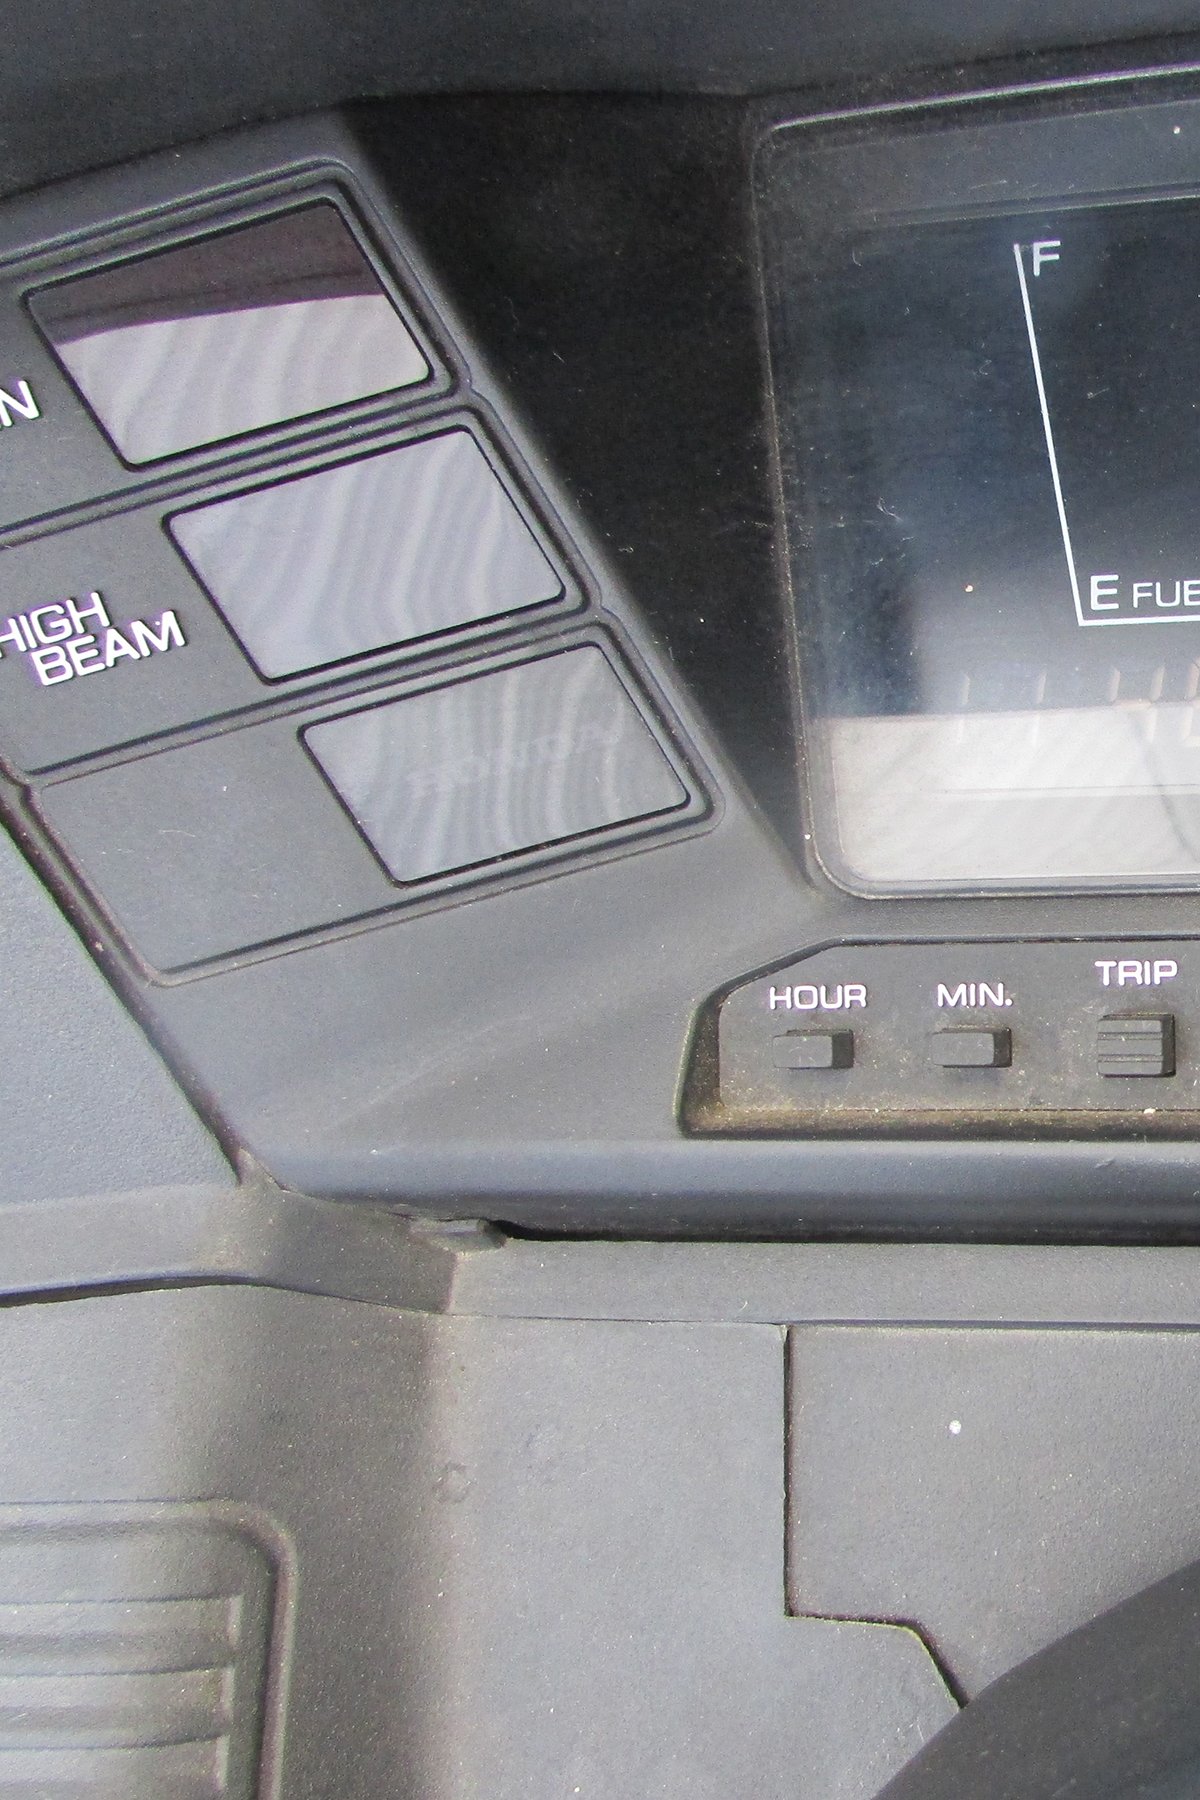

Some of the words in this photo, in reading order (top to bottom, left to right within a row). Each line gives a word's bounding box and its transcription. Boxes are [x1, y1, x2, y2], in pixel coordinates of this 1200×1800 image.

[1031, 240, 1062, 277] F
[1089, 574, 1119, 610] E
[0, 591, 110, 656] HIGH
[31, 610, 186, 686] BEAM
[1094, 960, 1179, 986] TRIP
[768, 984, 868, 1010] HOUR
[936, 983, 1014, 1007] MIN.
